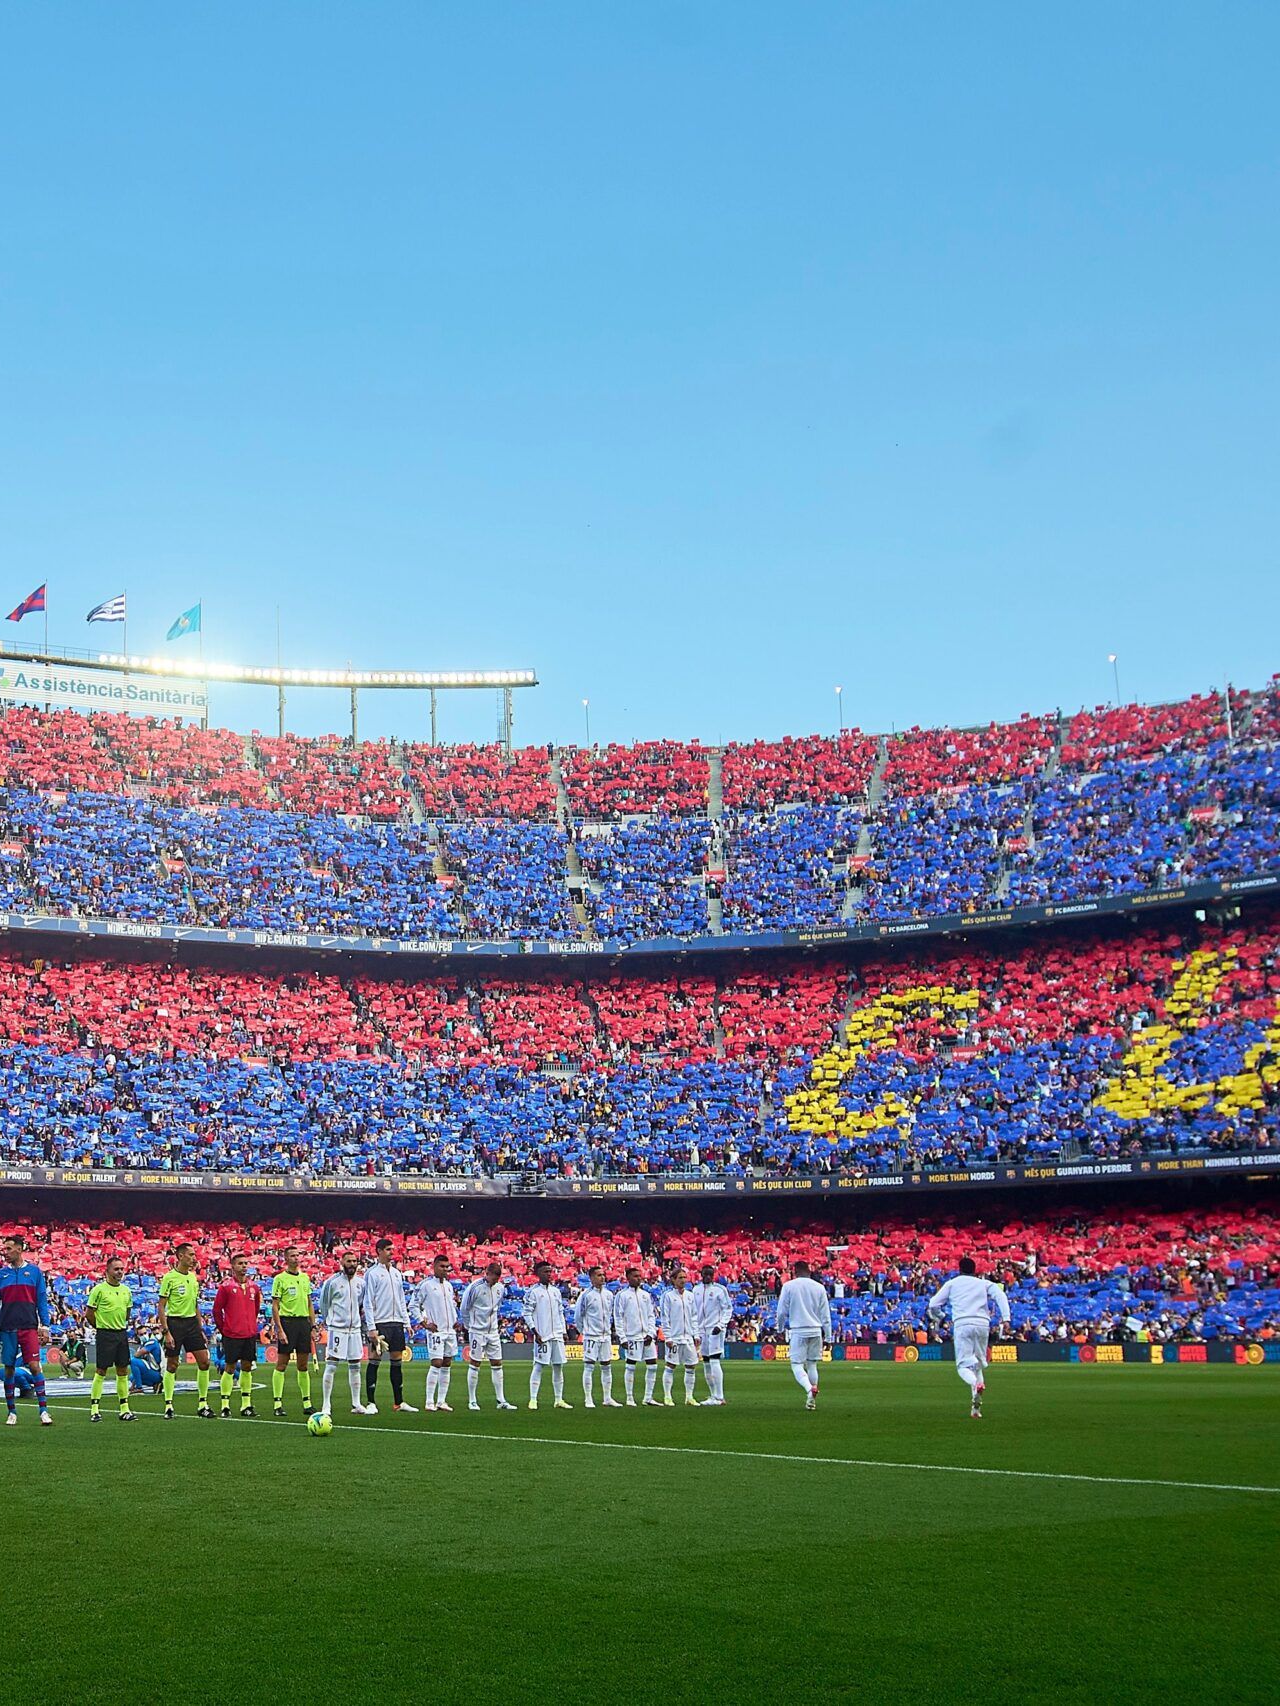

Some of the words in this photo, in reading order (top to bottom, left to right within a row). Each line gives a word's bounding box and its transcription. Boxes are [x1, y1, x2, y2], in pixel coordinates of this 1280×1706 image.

[14, 672, 122, 699] Assistència
[126, 685, 206, 707] Sanitària
[1239, 877, 1277, 888] BARCELONA
[1054, 907, 1063, 915] FC
[1063, 903, 1097, 913] BARCELONA
[107, 923, 162, 938] NIKE.COM/FCB
[896, 923, 929, 931] BARCELONA
[399, 941, 453, 953] NIKE.COM/FCB
[1157, 1160, 1180, 1170] MORE
[1182, 1160, 1203, 1169] THAN
[1204, 1157, 1240, 1168] WINNING
[1241, 1156, 1253, 1166] OR
[7, 1171, 32, 1180] PROUD
[1024, 1168, 1039, 1178] MÉS
[1040, 1169, 1056, 1179] QUE
[1056, 1167, 1093, 1176] GUANYAR
[1094, 1166, 1101, 1174] O
[1102, 1163, 1132, 1174] PERDRE
[62, 1172, 76, 1182] MÉS
[77, 1174, 91, 1183] QUE
[92, 1173, 117, 1183] TALENT
[140, 1175, 160, 1184] MORE
[161, 1176, 179, 1184] THAN
[180, 1176, 203, 1185] TALENT
[229, 1176, 241, 1186] MÉS
[242, 1178, 256, 1188] QUE
[257, 1178, 267, 1187] UN
[268, 1178, 284, 1187] CLUB
[838, 1177, 852, 1187] MÉS
[853, 1178, 867, 1189] QUE
[868, 1176, 904, 1186] PARAULES
[928, 1174, 949, 1183] MORE
[950, 1173, 969, 1182] THAN
[970, 1172, 995, 1181] WORDS
[323, 1180, 336, 1189] QUE
[343, 1180, 377, 1189] JUGADORS
[398, 1182, 416, 1190] MORE
[417, 1182, 433, 1190] THAN
[440, 1182, 467, 1191] PLAYERS
[588, 1182, 602, 1192] MÉS
[603, 1184, 617, 1194] QUE
[618, 1182, 640, 1192] MÀGIA
[664, 1182, 684, 1190] MORE
[685, 1182, 703, 1190] THAN
[704, 1182, 725, 1190] MAGIC
[753, 1180, 767, 1190] MÉS
[768, 1181, 782, 1191] QUE
[783, 1181, 793, 1189] UN
[794, 1180, 811, 1188] CLUB
[334, 1336, 340, 1347] 9
[432, 1336, 441, 1345] 14
[472, 1340, 477, 1349] 8
[587, 1338, 596, 1348] 17
[629, 1341, 638, 1350] 21
[537, 1344, 548, 1354] 20
